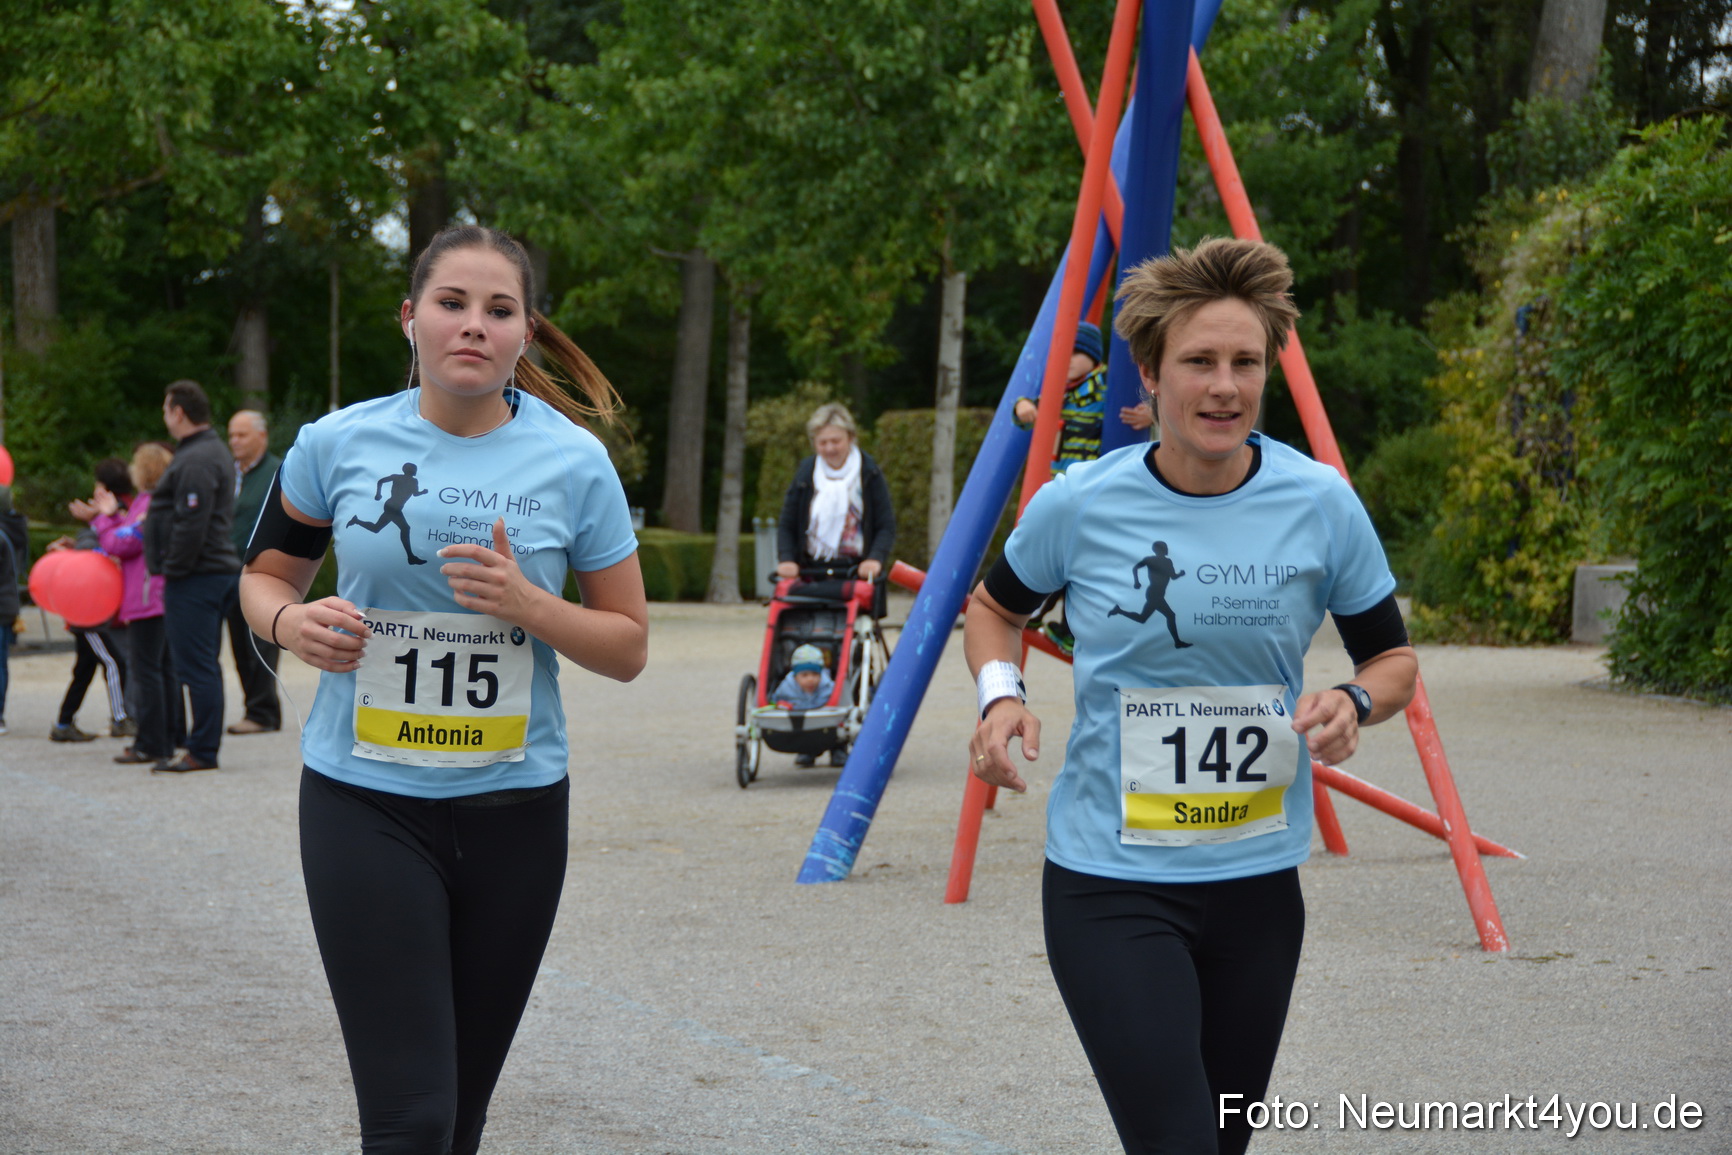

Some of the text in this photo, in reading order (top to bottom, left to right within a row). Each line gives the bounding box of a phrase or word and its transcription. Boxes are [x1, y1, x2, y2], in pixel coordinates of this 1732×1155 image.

[439, 487, 541, 517] GYM HIP
[448, 515, 520, 538] P-Semar
[1197, 564, 1298, 585] GYM HIP
[1211, 596, 1280, 610] P-Seminar
[1193, 612, 1290, 627] Halbmarathon
[423, 627, 505, 645] Neumarkt
[394, 648, 499, 709] 115
[1126, 702, 1271, 717] PARTL Neumarkt
[397, 720, 483, 746] Antonia
[1161, 725, 1269, 785] 142
[1174, 801, 1249, 824] Sandra
